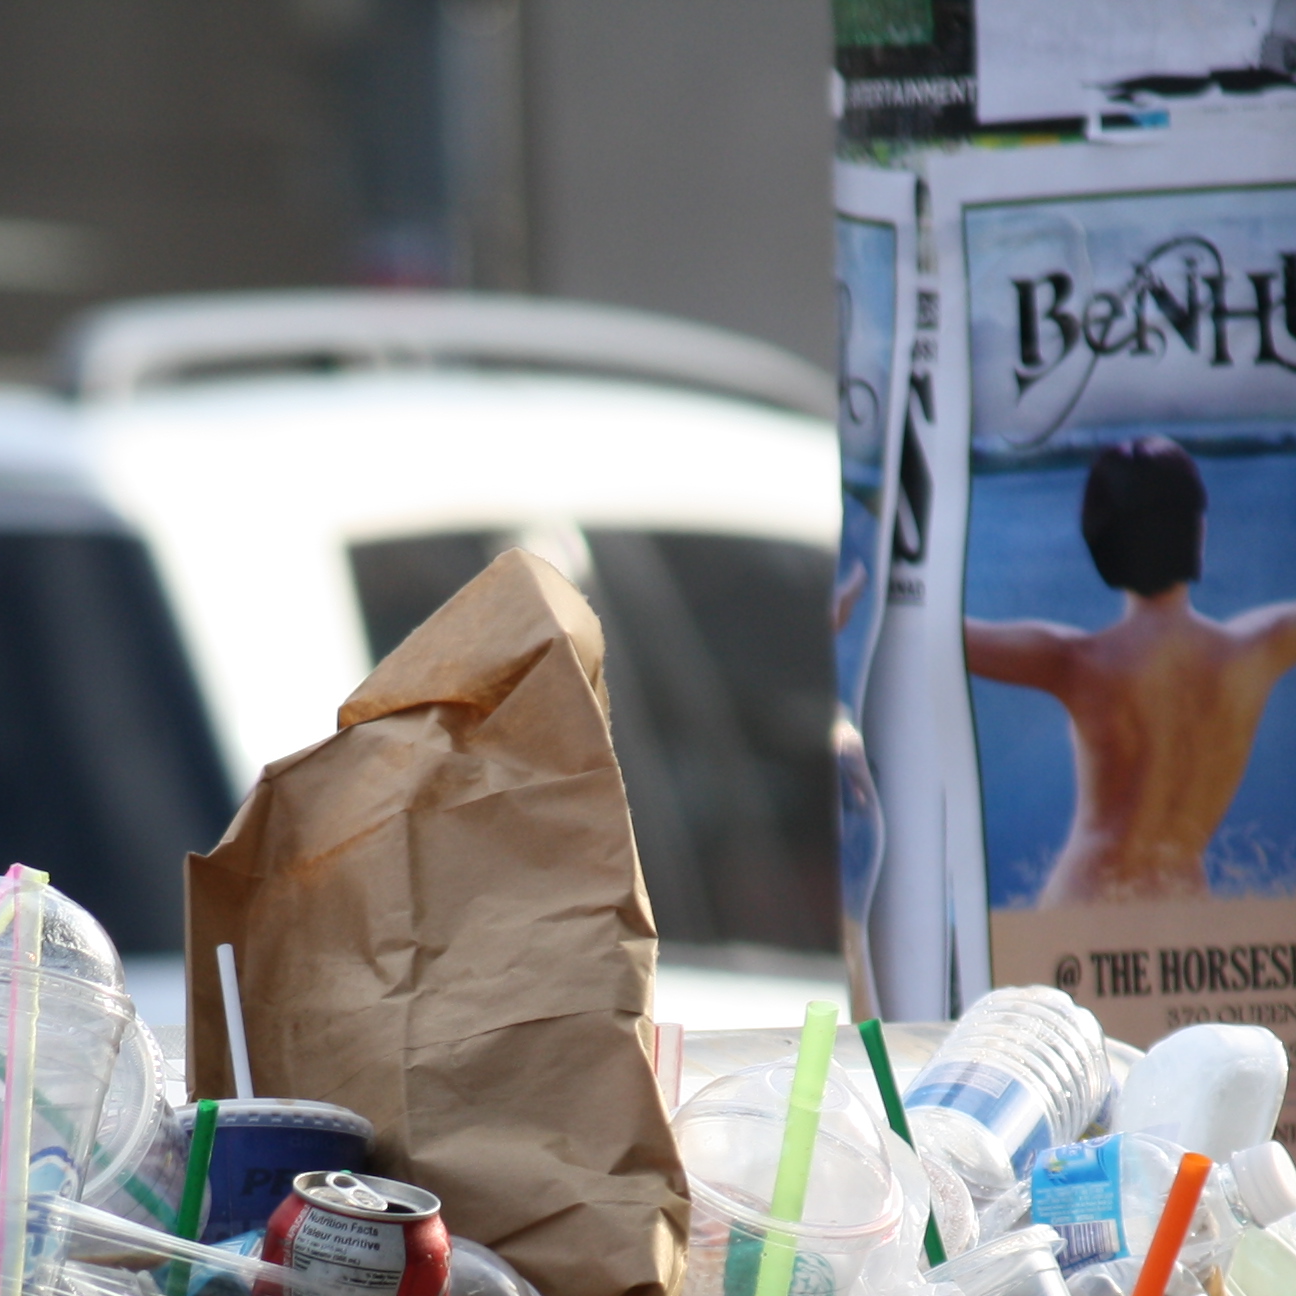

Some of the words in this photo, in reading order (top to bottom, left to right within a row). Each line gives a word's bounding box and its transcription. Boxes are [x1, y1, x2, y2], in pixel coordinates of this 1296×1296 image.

[1091, 952, 1150, 999] THE
[302, 1222, 332, 1242] Valeur
[333, 1234, 381, 1252] nutritive
[310, 1212, 349, 1234] Nutrition
[350, 1222, 379, 1238] Facts
